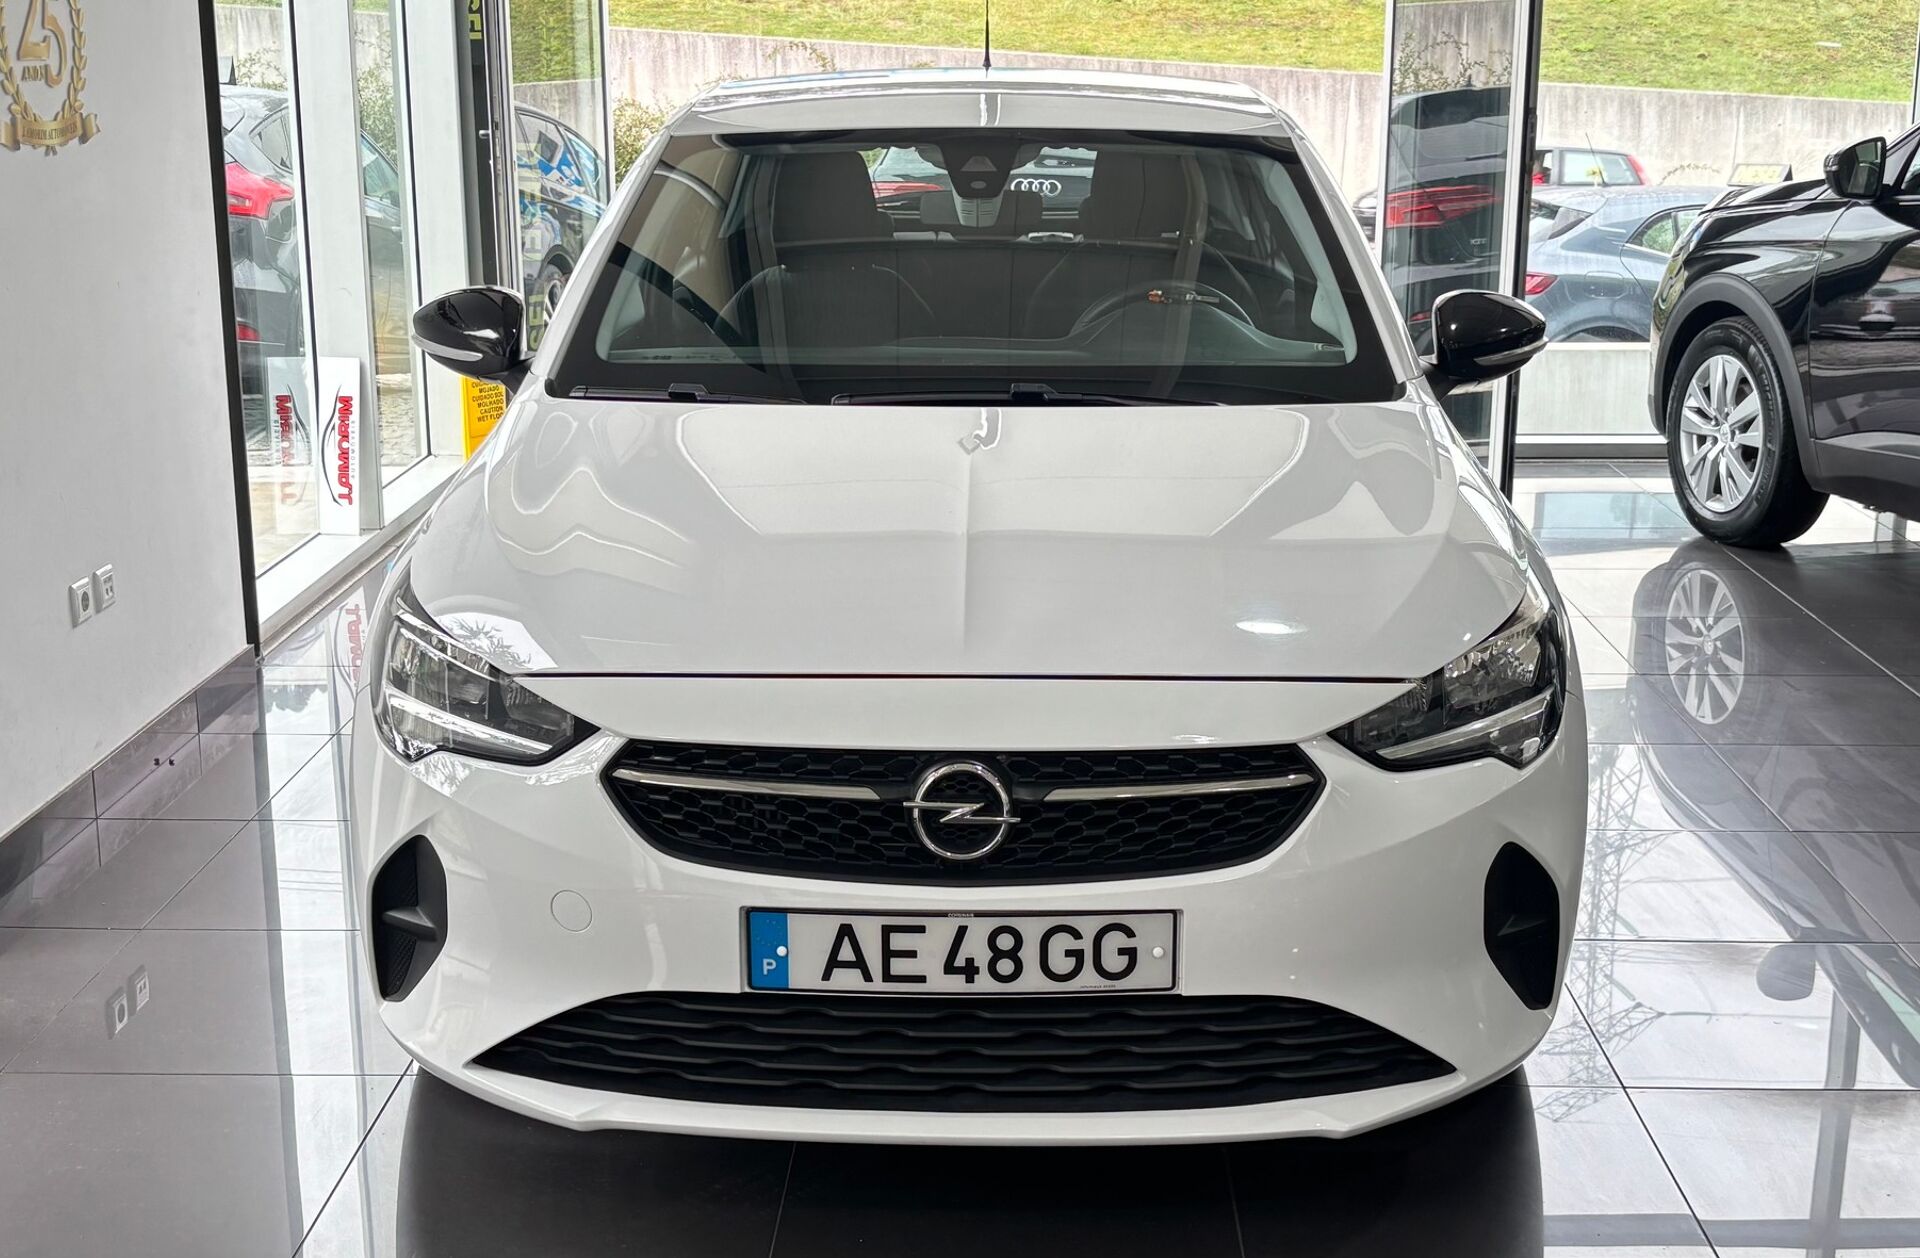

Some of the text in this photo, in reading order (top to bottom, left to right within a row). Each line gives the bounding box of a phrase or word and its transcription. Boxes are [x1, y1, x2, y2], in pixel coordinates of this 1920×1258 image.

[479, 406, 503, 415] CAUTION
[337, 395, 353, 505] J.AMORIM
[762, 958, 777, 975] P
[820, 922, 1139, 984] AE 48 GG
